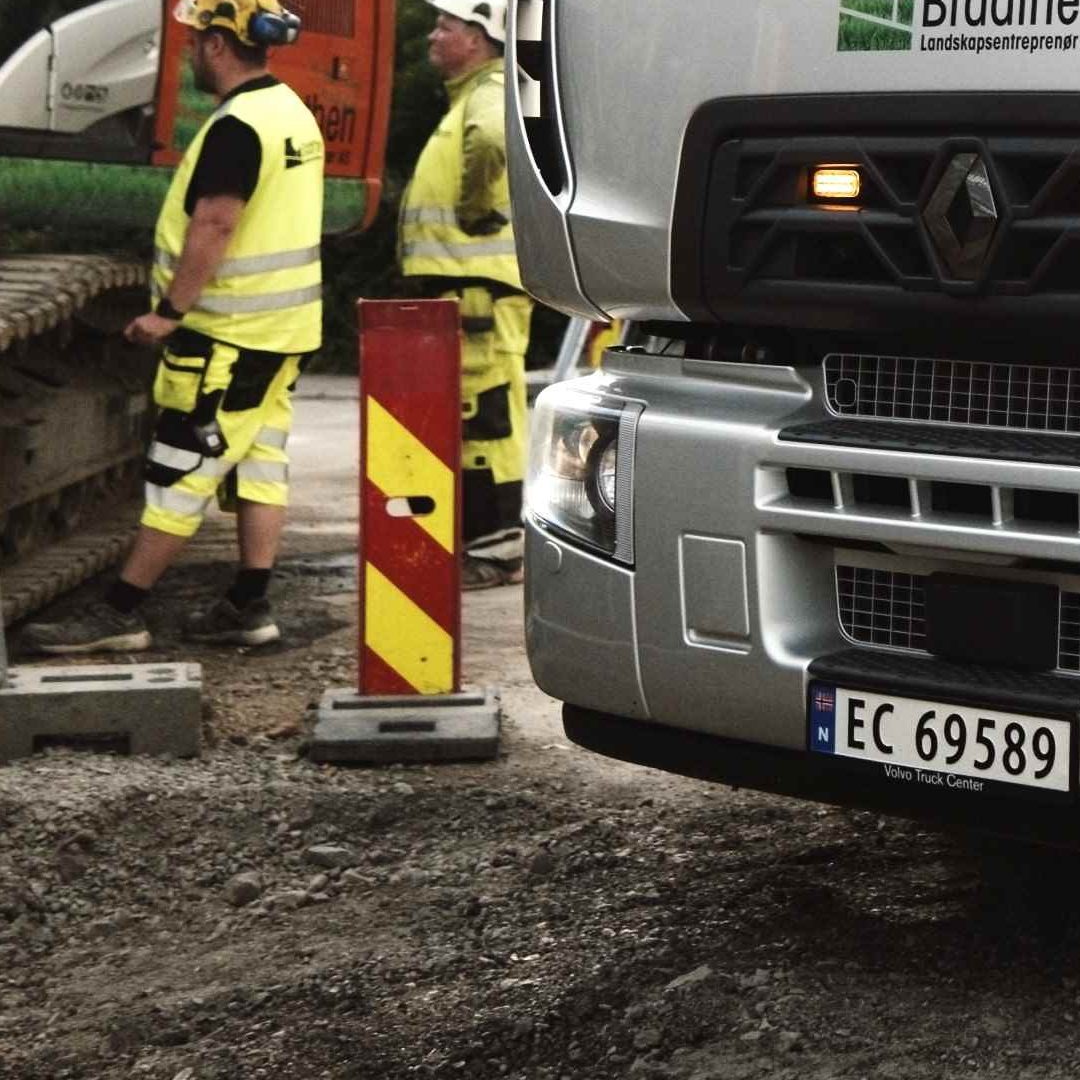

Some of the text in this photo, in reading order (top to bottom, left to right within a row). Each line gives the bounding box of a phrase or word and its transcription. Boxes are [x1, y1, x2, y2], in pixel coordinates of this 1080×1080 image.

[920, 32, 1078, 54] Landskapsentreprenør
[818, 697, 1057, 780] N EC 69589
[884, 764, 985, 792] Volvo Truck Center
